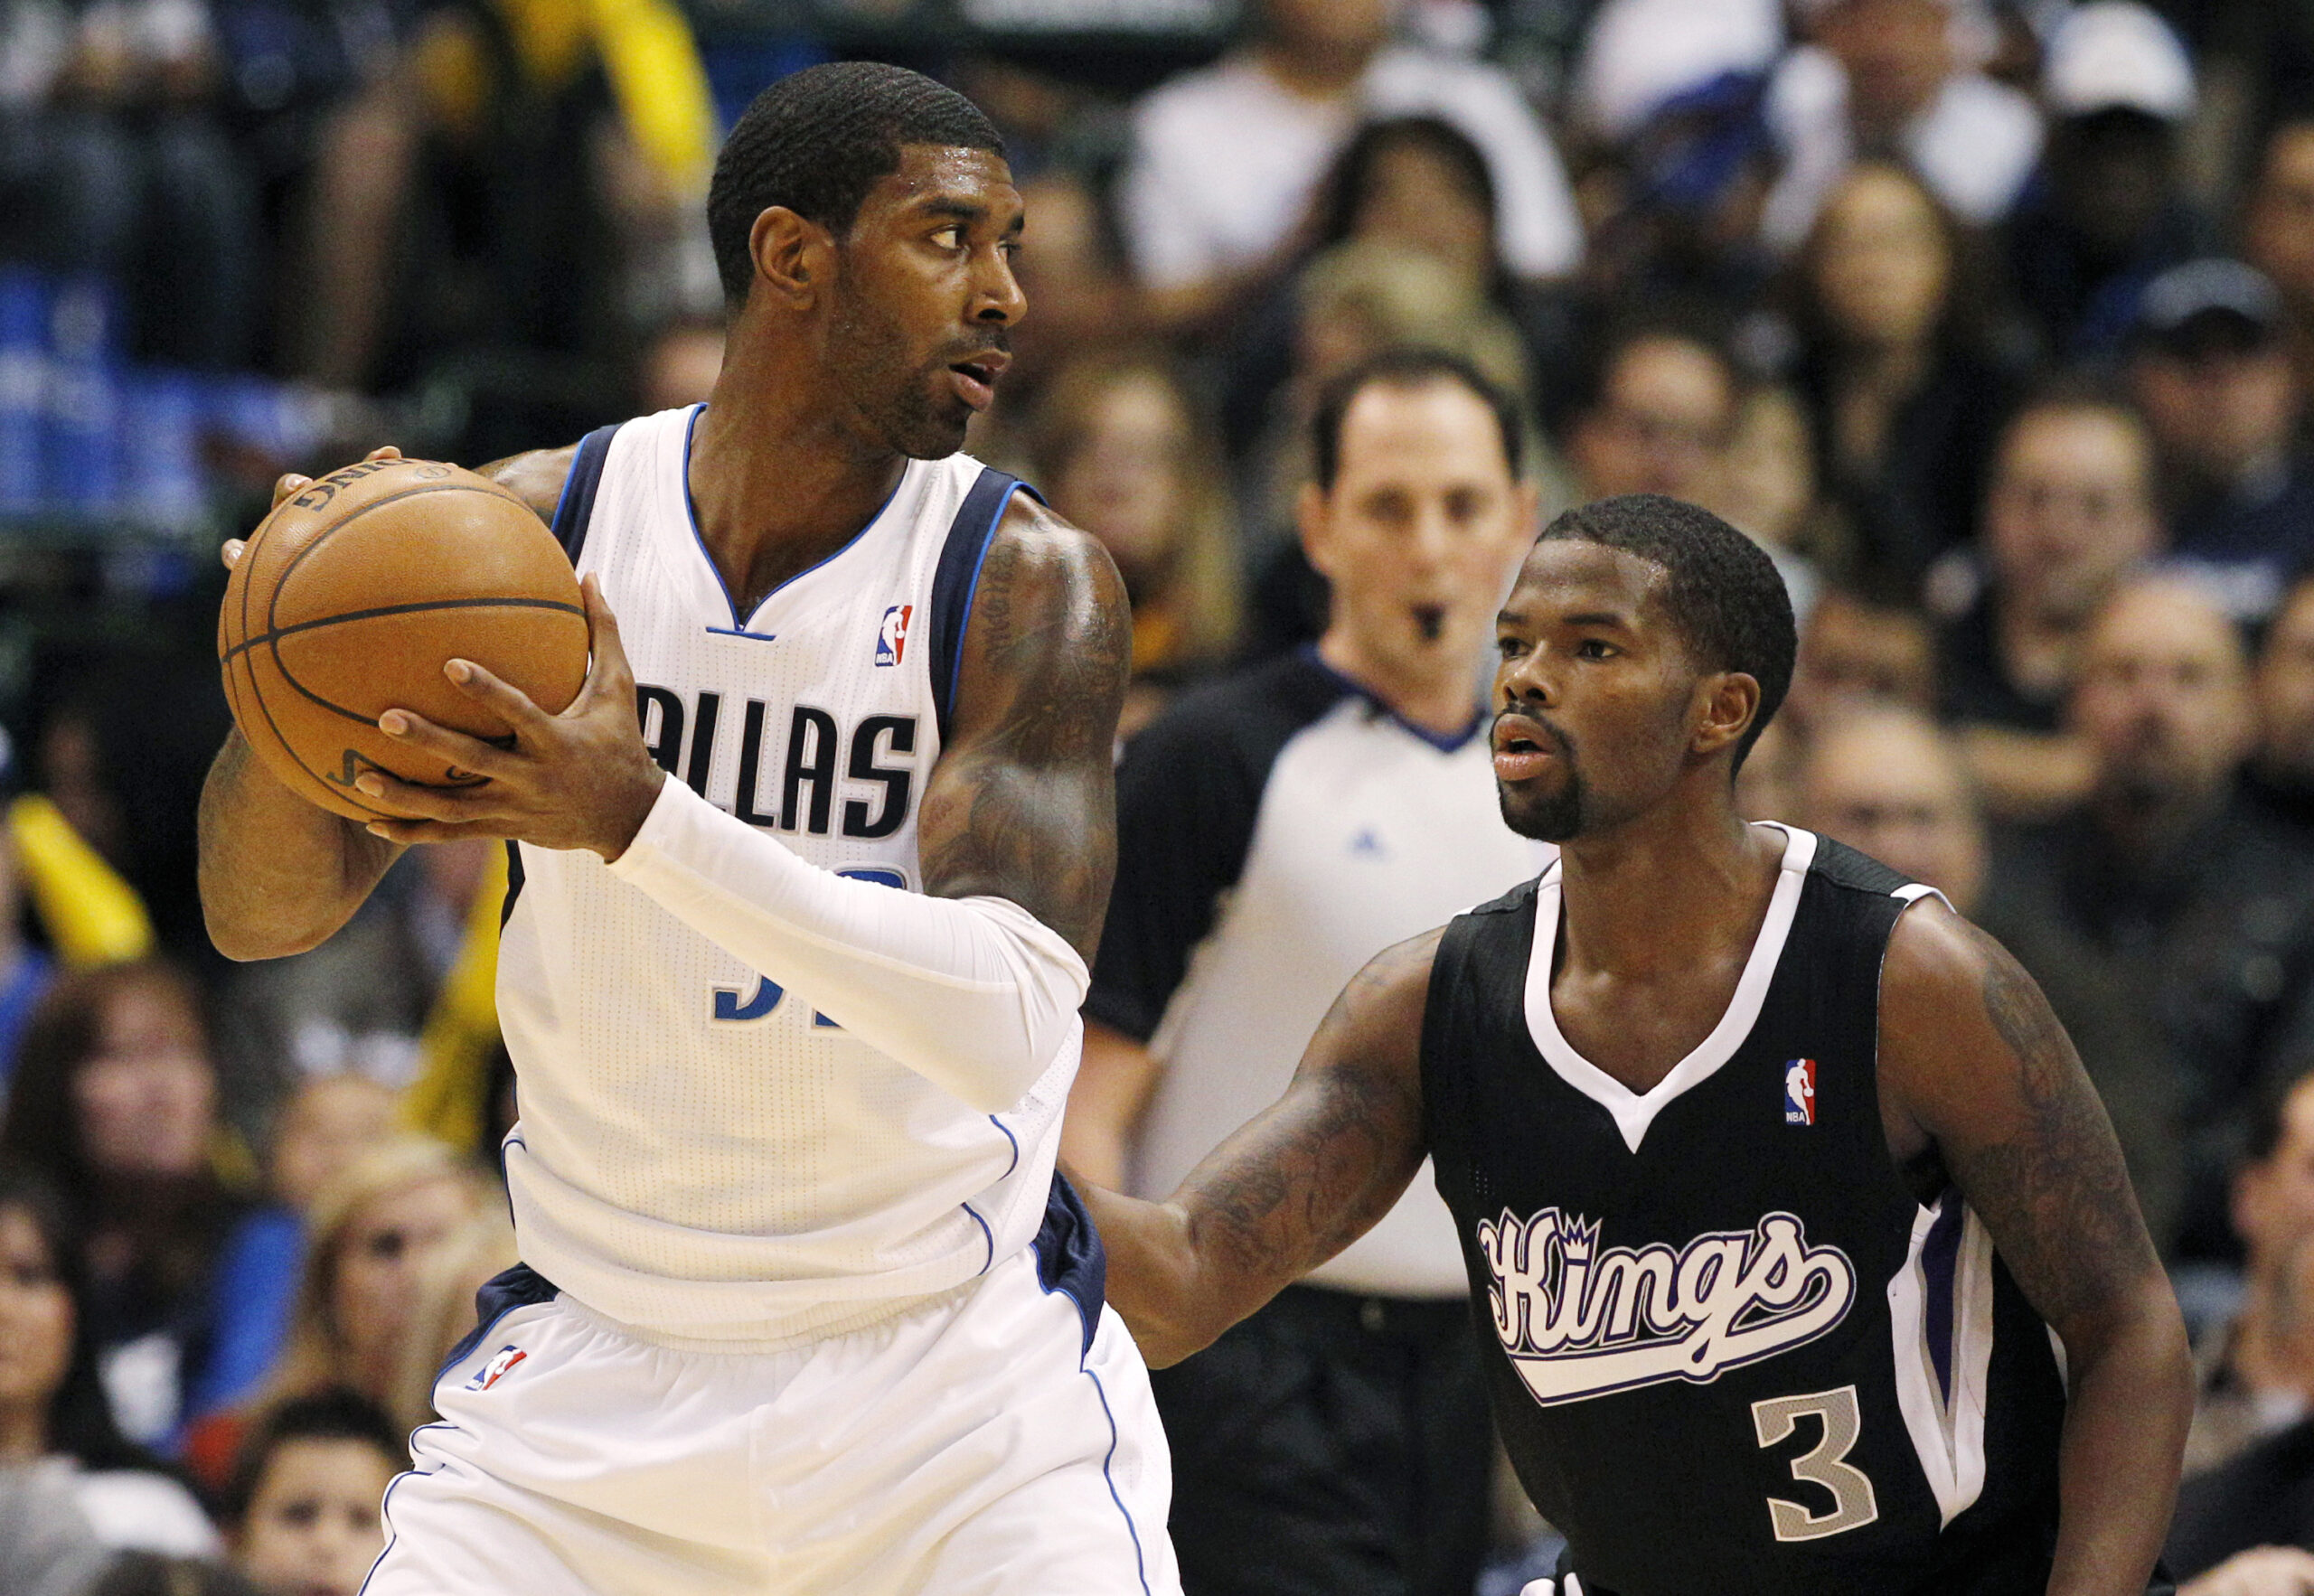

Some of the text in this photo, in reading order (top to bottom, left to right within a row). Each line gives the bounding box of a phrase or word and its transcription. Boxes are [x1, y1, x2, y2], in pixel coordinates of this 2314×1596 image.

[876, 652, 893, 663] NBA
[635, 683, 919, 841] ALLAS
[1786, 1112, 1806, 1122] NBA
[1478, 1206, 1857, 1406] Kings
[1751, 1385, 1878, 1542] 3
